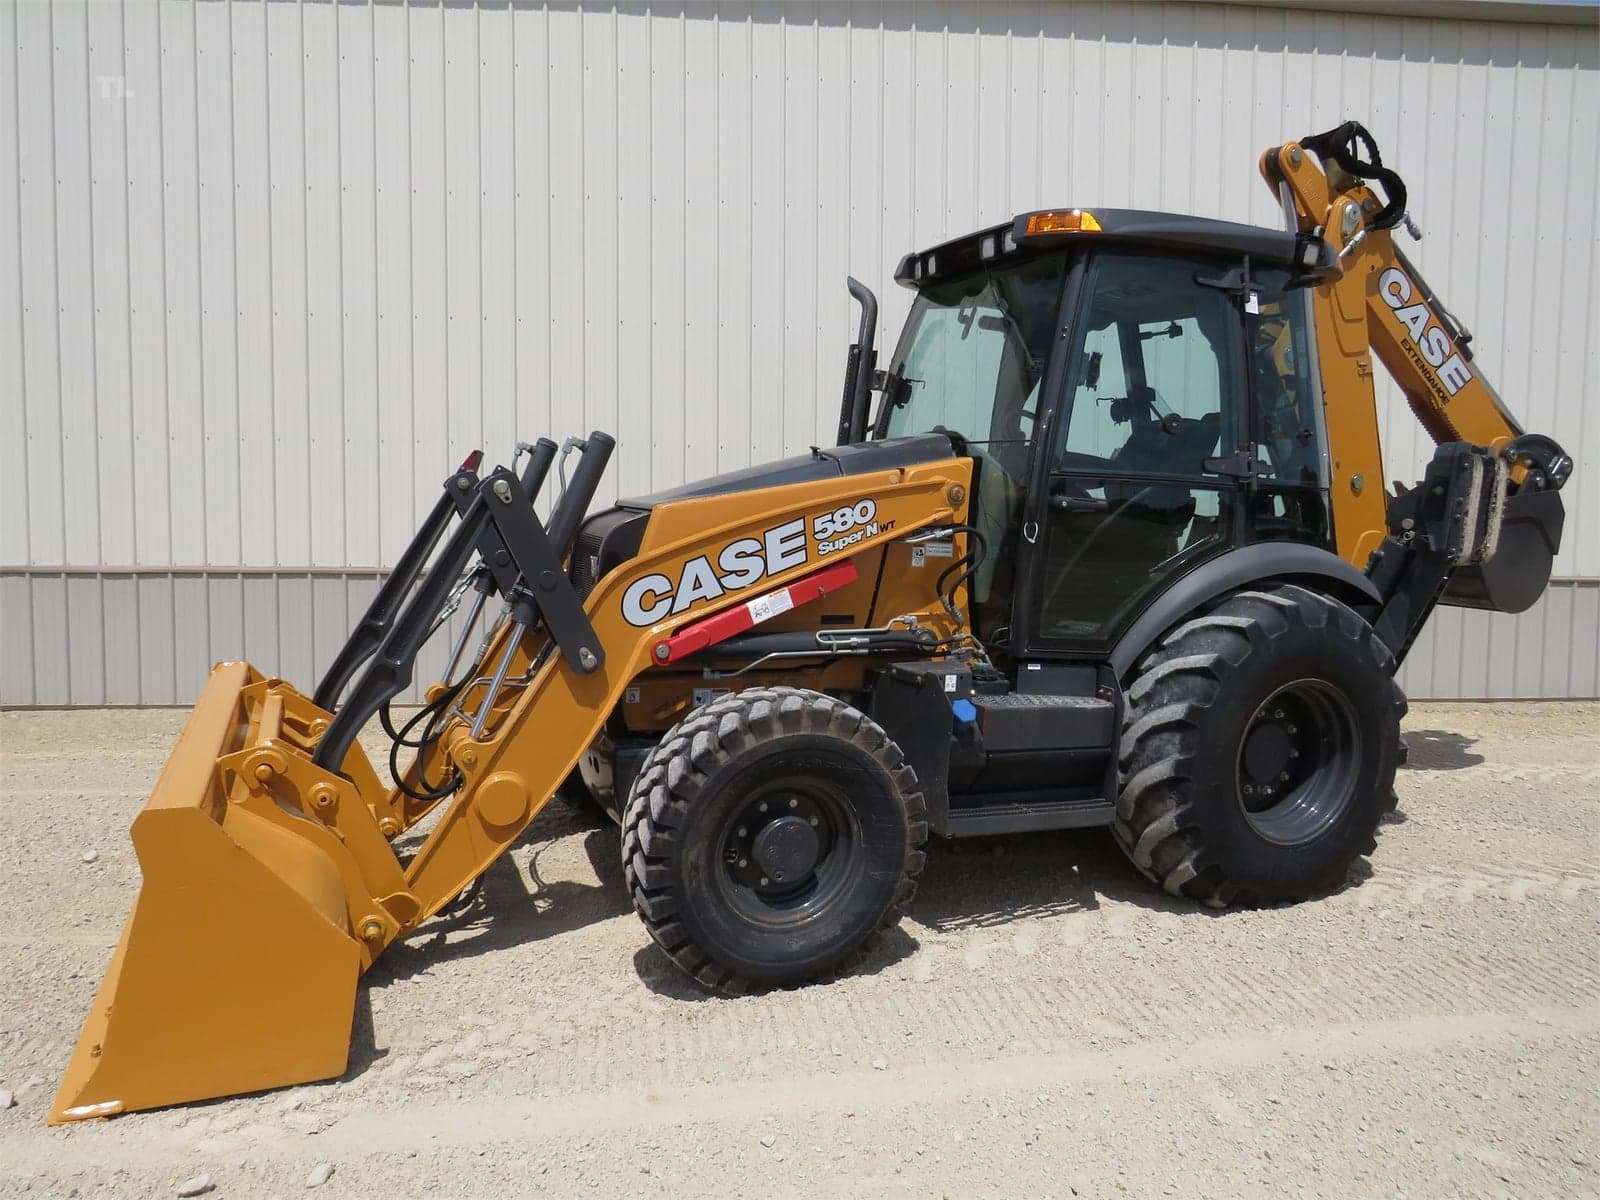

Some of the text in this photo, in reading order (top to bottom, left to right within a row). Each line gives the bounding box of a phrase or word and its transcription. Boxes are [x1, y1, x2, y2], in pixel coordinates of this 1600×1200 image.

[1378, 267, 1473, 396] CASE
[1401, 338, 1449, 403] EXTENDAHOE
[813, 498, 876, 540] 580
[818, 520, 896, 556] Super N WT
[620, 516, 808, 627] CASE
